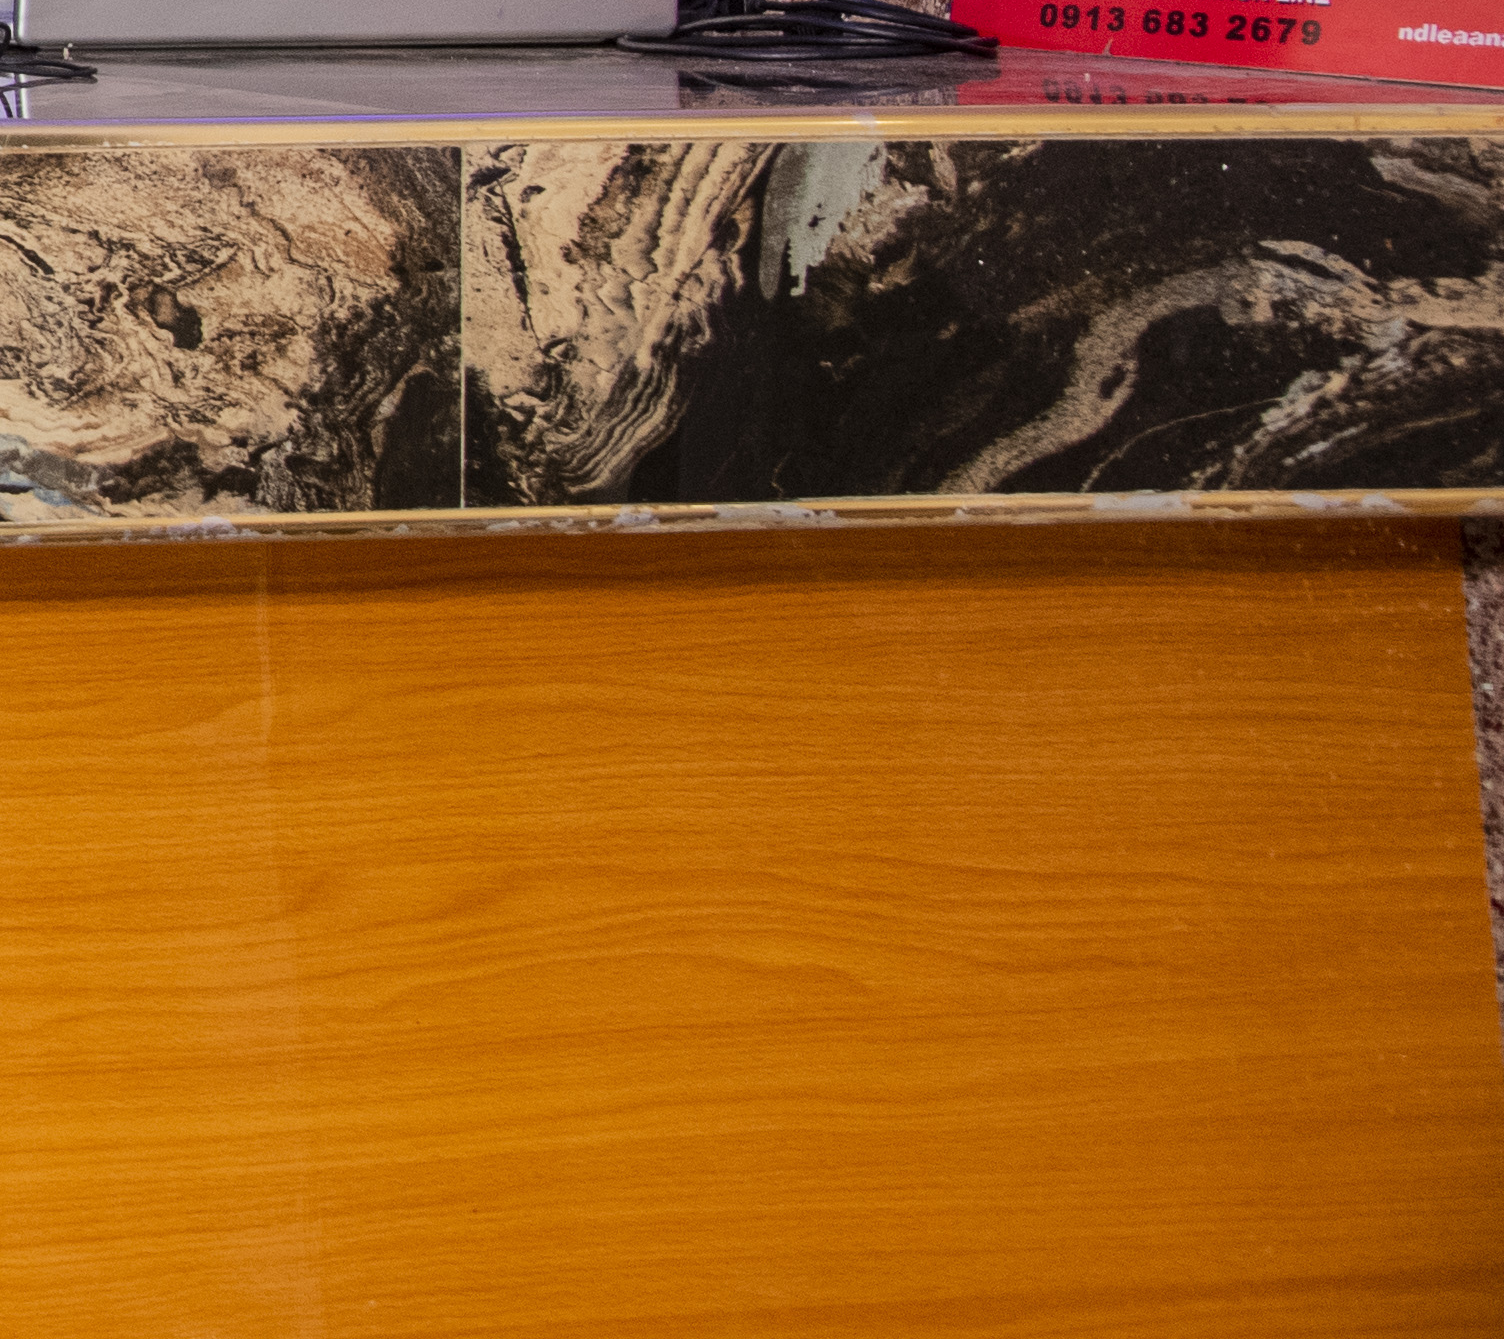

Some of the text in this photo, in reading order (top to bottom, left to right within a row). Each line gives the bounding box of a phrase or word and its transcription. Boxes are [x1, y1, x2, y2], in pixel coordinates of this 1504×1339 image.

[1040, 4, 1322, 45] 0913 683 2679
[1398, 23, 1504, 48] ndleaan
